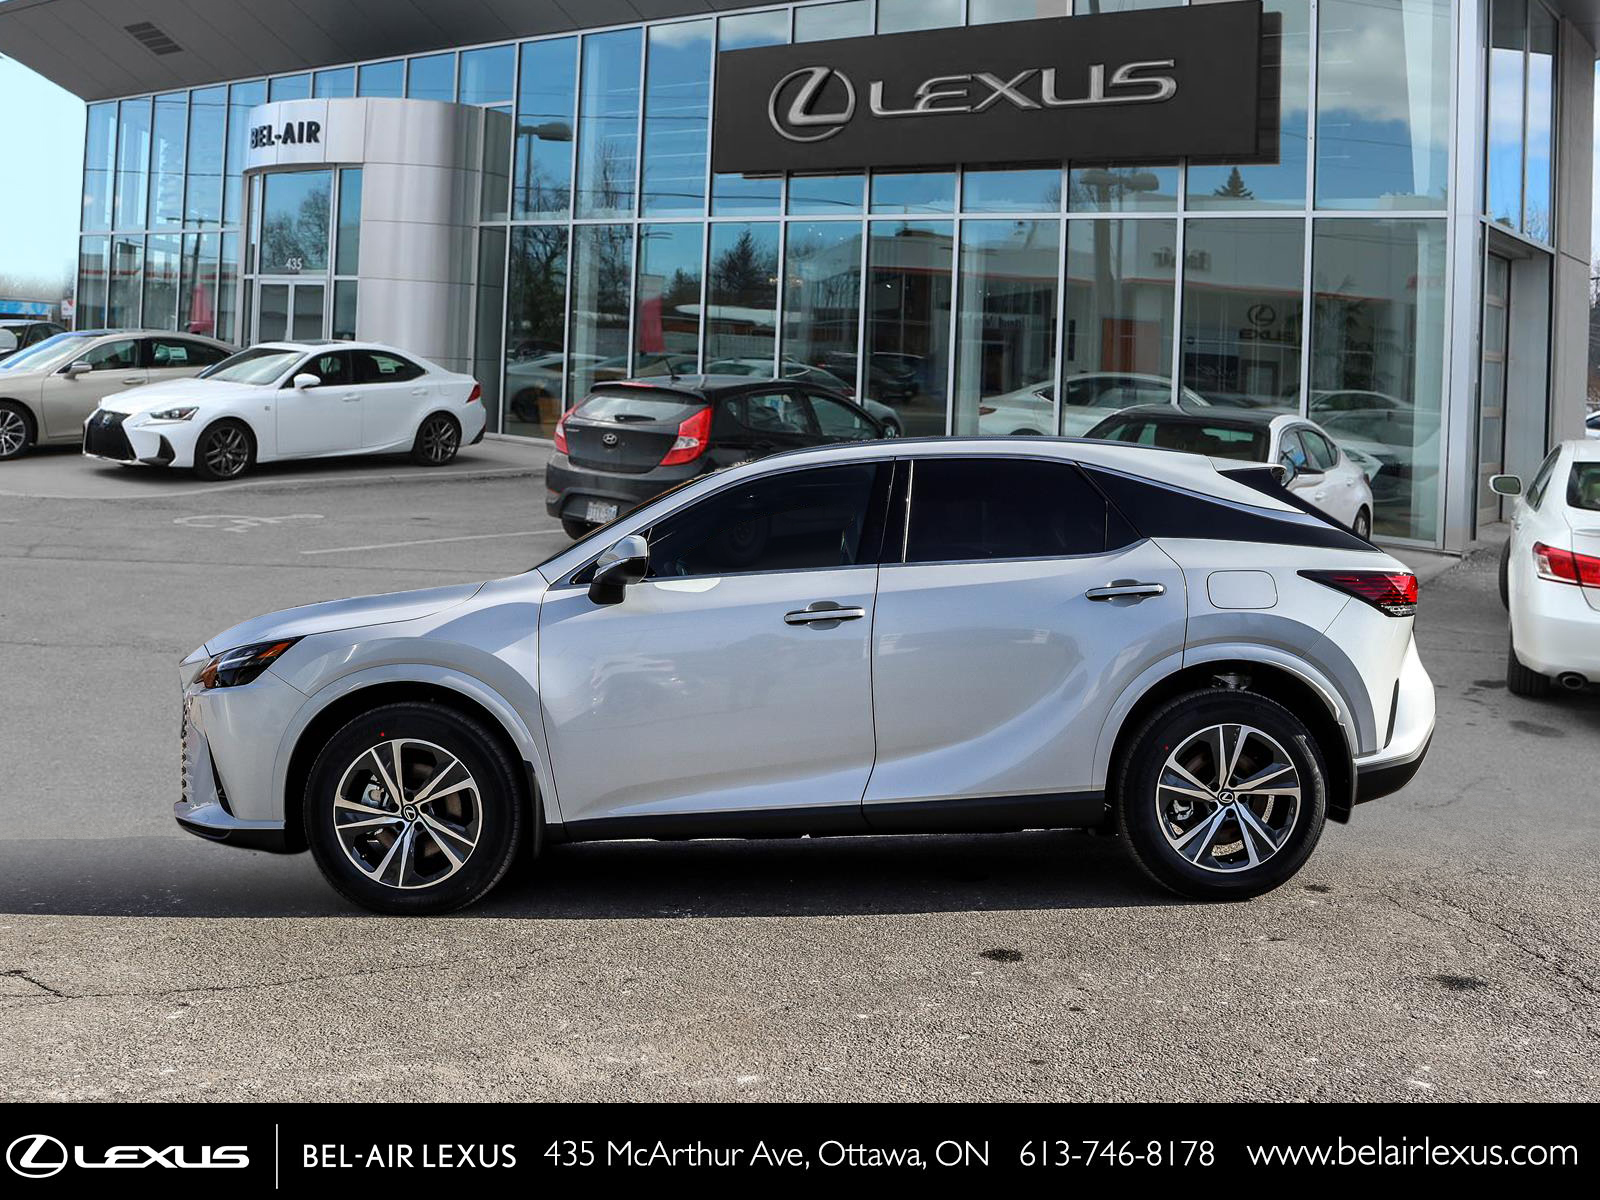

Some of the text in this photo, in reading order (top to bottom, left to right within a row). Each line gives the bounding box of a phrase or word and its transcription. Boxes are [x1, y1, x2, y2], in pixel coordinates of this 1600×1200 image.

[869, 59, 1178, 118] LEXUS
[250, 120, 321, 149] BEL-AIR
[285, 257, 303, 270] 435
